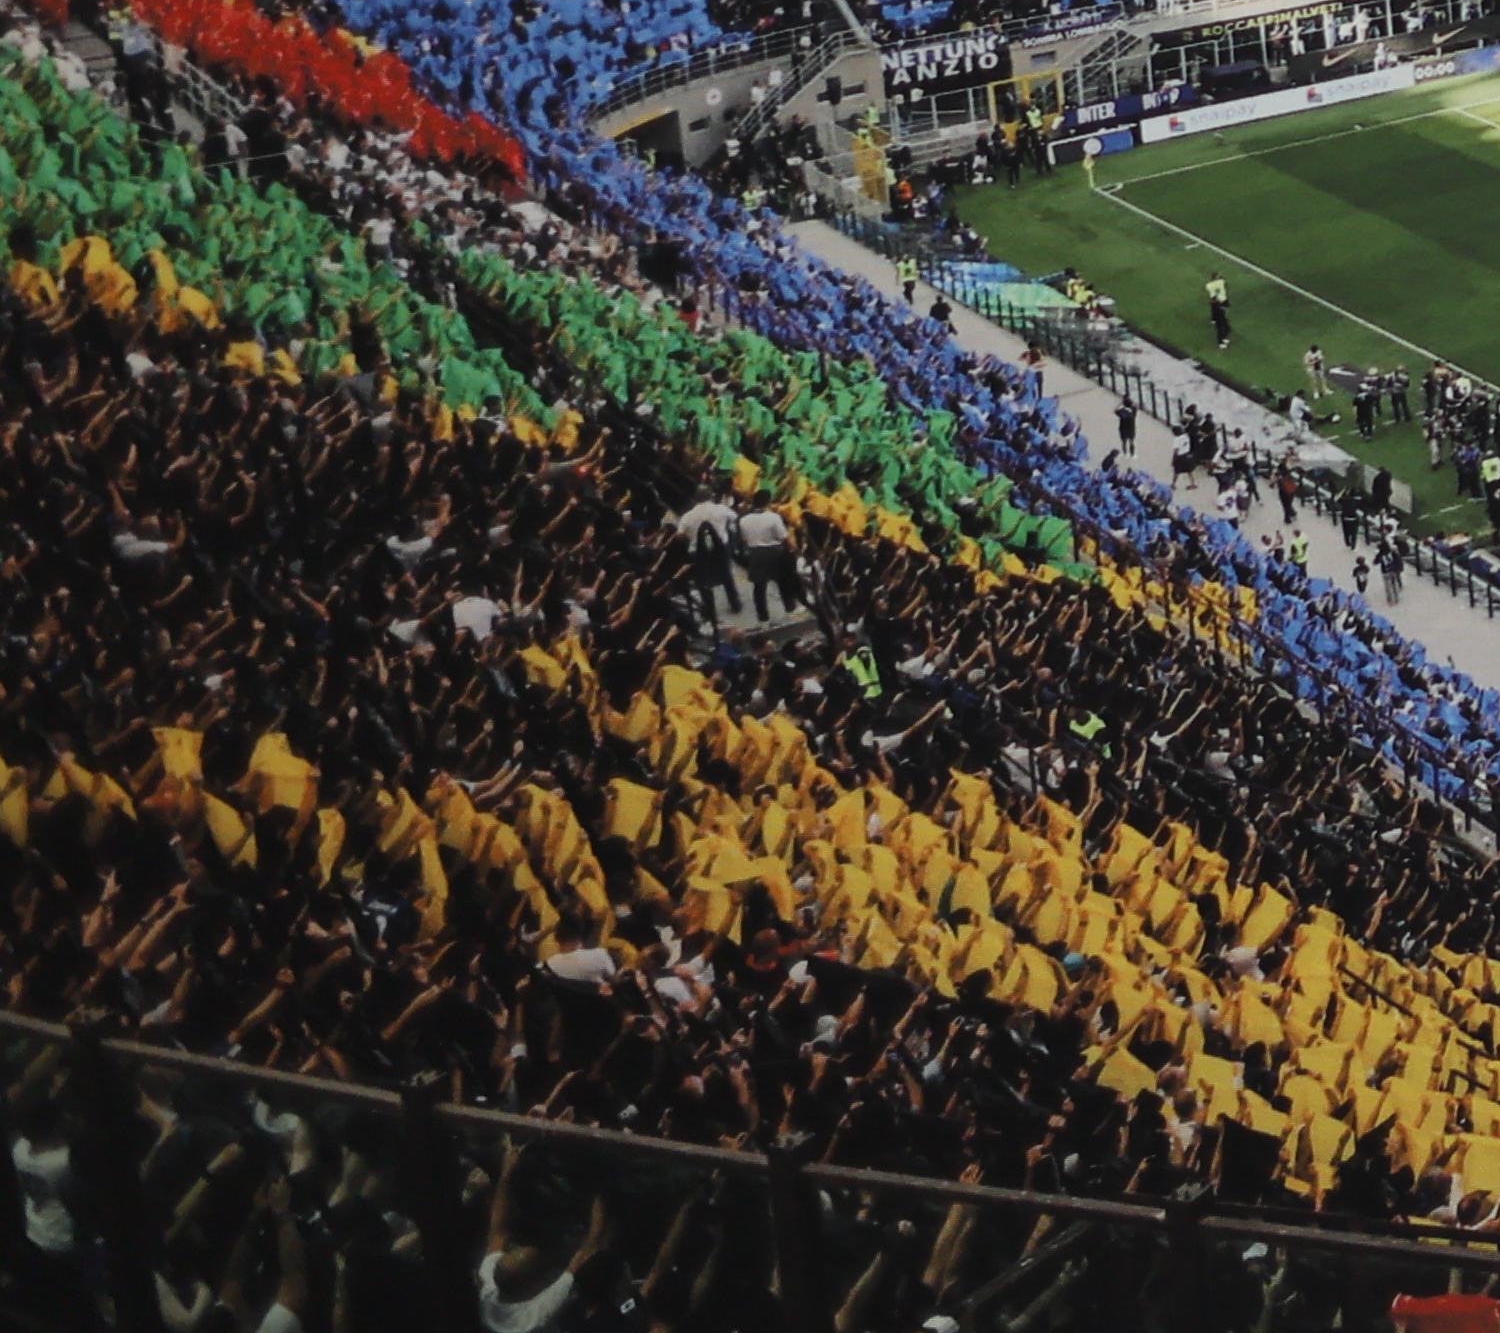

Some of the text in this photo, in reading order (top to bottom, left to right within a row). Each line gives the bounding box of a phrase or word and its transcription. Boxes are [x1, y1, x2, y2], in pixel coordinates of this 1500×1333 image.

[1202, 2, 1344, 37] ROCCASPINALVETI
[892, 52, 999, 86] ANZIO
[1415, 61, 1455, 80] 00:00
[1077, 101, 1116, 124] INTER
